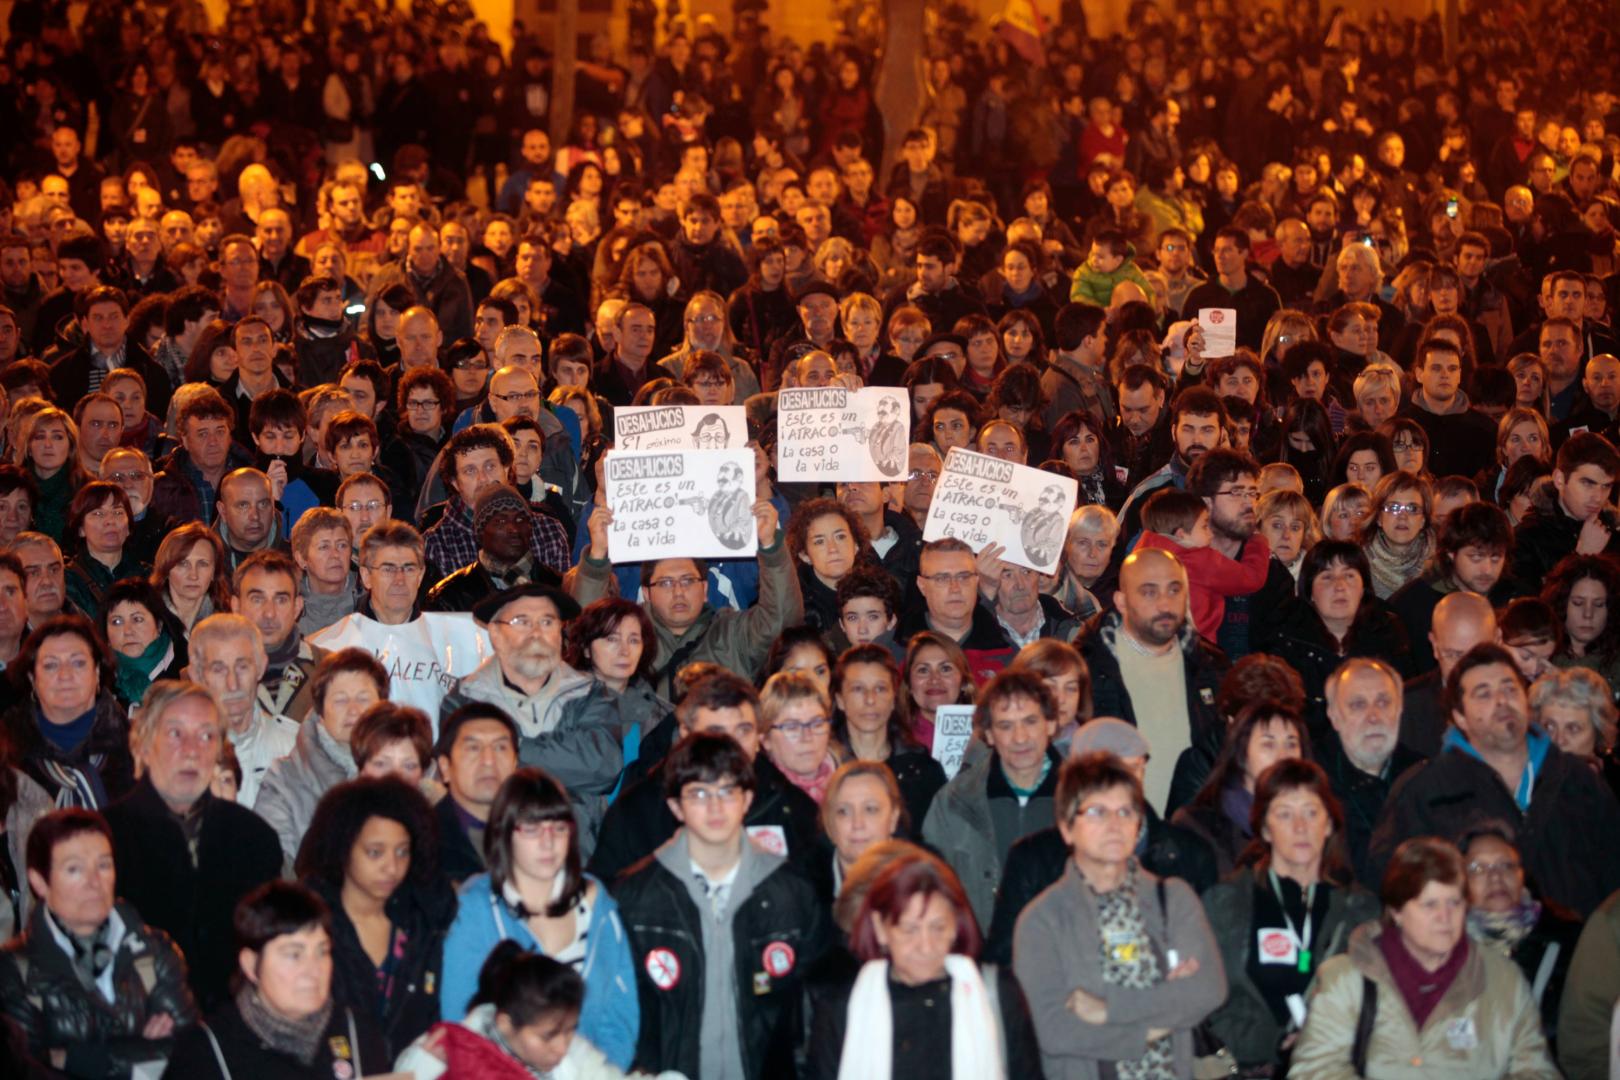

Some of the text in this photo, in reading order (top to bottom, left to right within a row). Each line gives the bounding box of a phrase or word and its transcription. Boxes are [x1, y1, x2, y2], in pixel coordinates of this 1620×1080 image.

[781, 389, 847, 408] DESAHUCIOS
[618, 407, 684, 436] DESAHUCIOS
[785, 411, 857, 426] Este es un
[799, 445, 825, 457] casa
[611, 455, 683, 480] DESAHUCIOS
[795, 458, 840, 472] la vida
[944, 451, 1014, 482] DESAHUCIOS
[616, 479, 696, 497] Este es un
[943, 474, 1019, 500] Este es un
[632, 517, 660, 530] casa
[950, 511, 978, 525] casa
[627, 530, 676, 547] la vida
[943, 523, 988, 544] la vida
